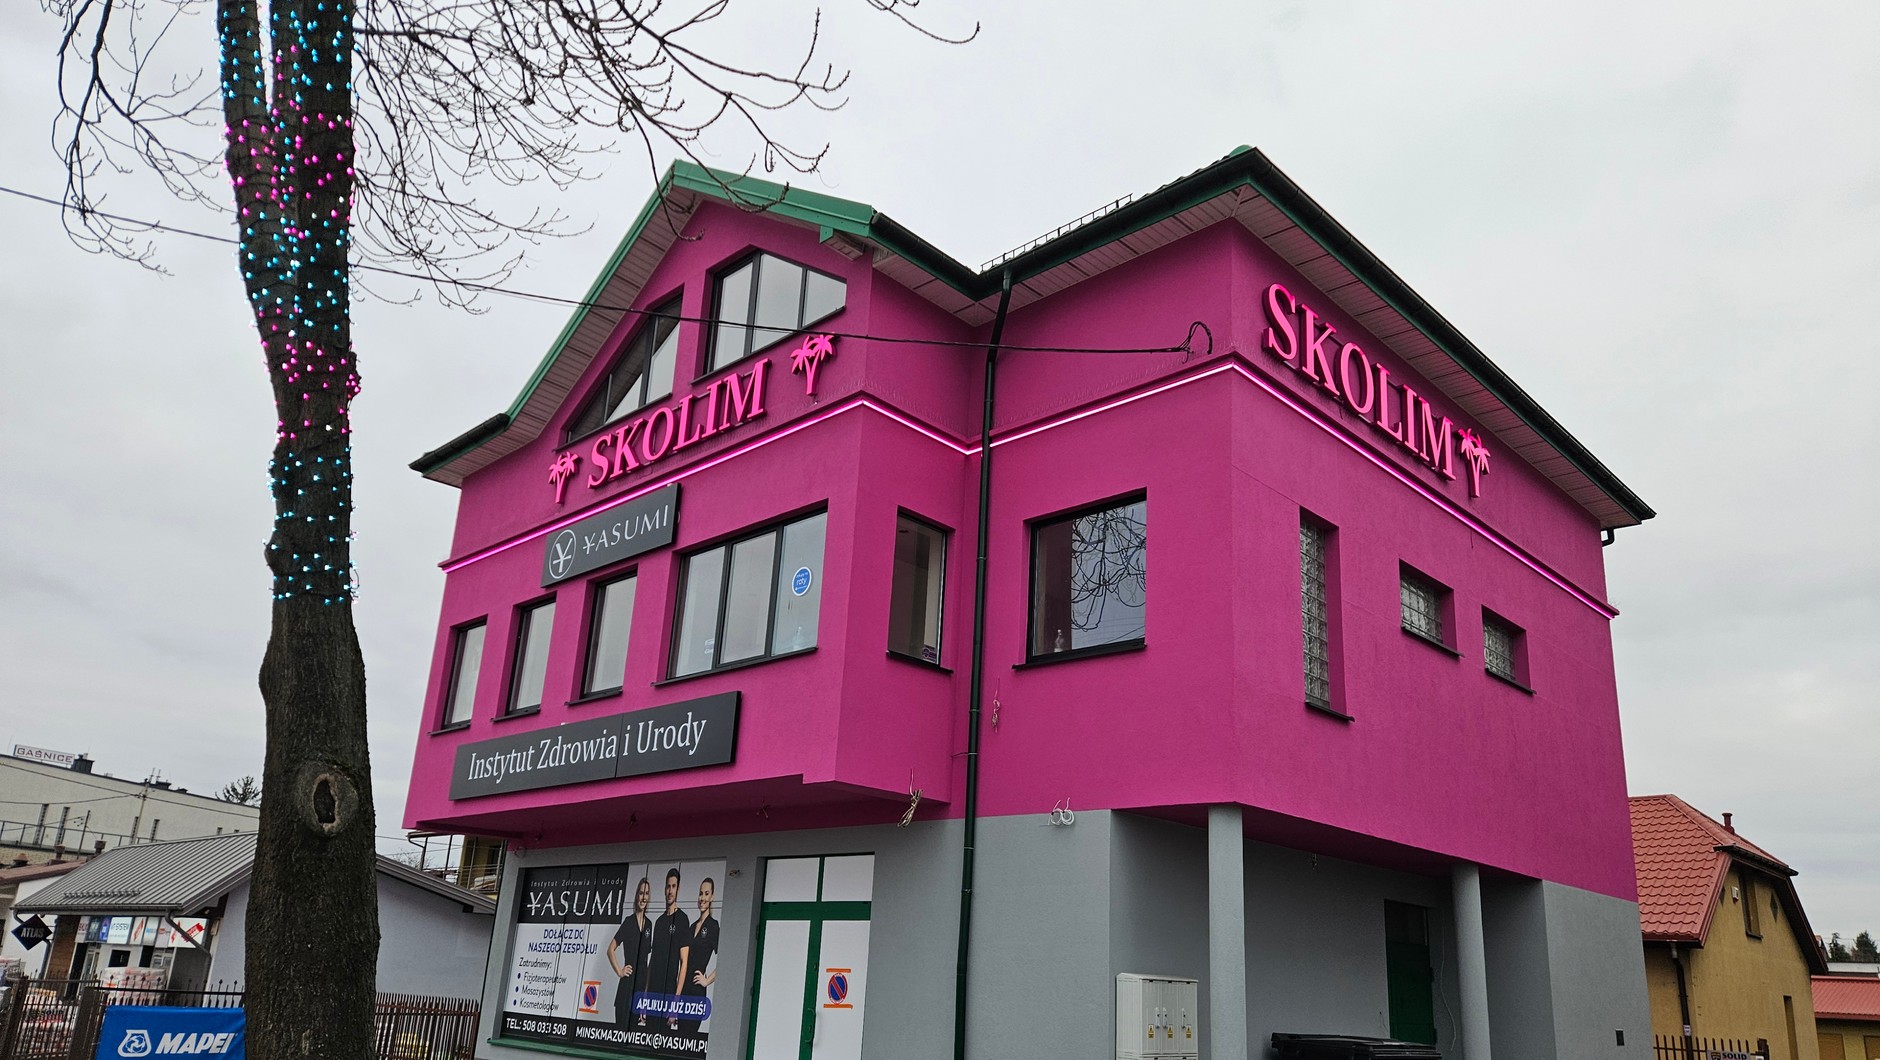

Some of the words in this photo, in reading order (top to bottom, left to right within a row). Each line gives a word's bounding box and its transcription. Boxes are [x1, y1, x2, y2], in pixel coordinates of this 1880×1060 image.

[1262, 283, 1457, 481] SKOLIM
[587, 358, 772, 488] SKOLIM
[17, 747, 73, 764] GAŚNICE
[468, 746, 534, 784] Instytut
[537, 729, 617, 770] Zdrowia
[622, 724, 630, 756] i
[637, 711, 707, 756] Urody
[531, 880, 558, 888] Instytut
[562, 878, 590, 887] Zdrowia
[602, 877, 624, 886] Urody
[20, 927, 44, 938] ATLAS
[528, 942, 561, 954] NASZEGO
[562, 942, 598, 955] ZESPOŁU!
[519, 957, 552, 971] Zatrudnimy:
[521, 985, 555, 997] Masażystów
[519, 998, 559, 1013] Kosmetologów
[636, 998, 668, 1012] APLIKUJ
[668, 999, 684, 1014] JUŻ
[684, 1001, 707, 1015] DZIŚ!
[522, 1019, 536, 1032] 508
[537, 1022, 551, 1034] 033
[552, 1024, 567, 1036] 508
[155, 1032, 235, 1054] MAPEI
